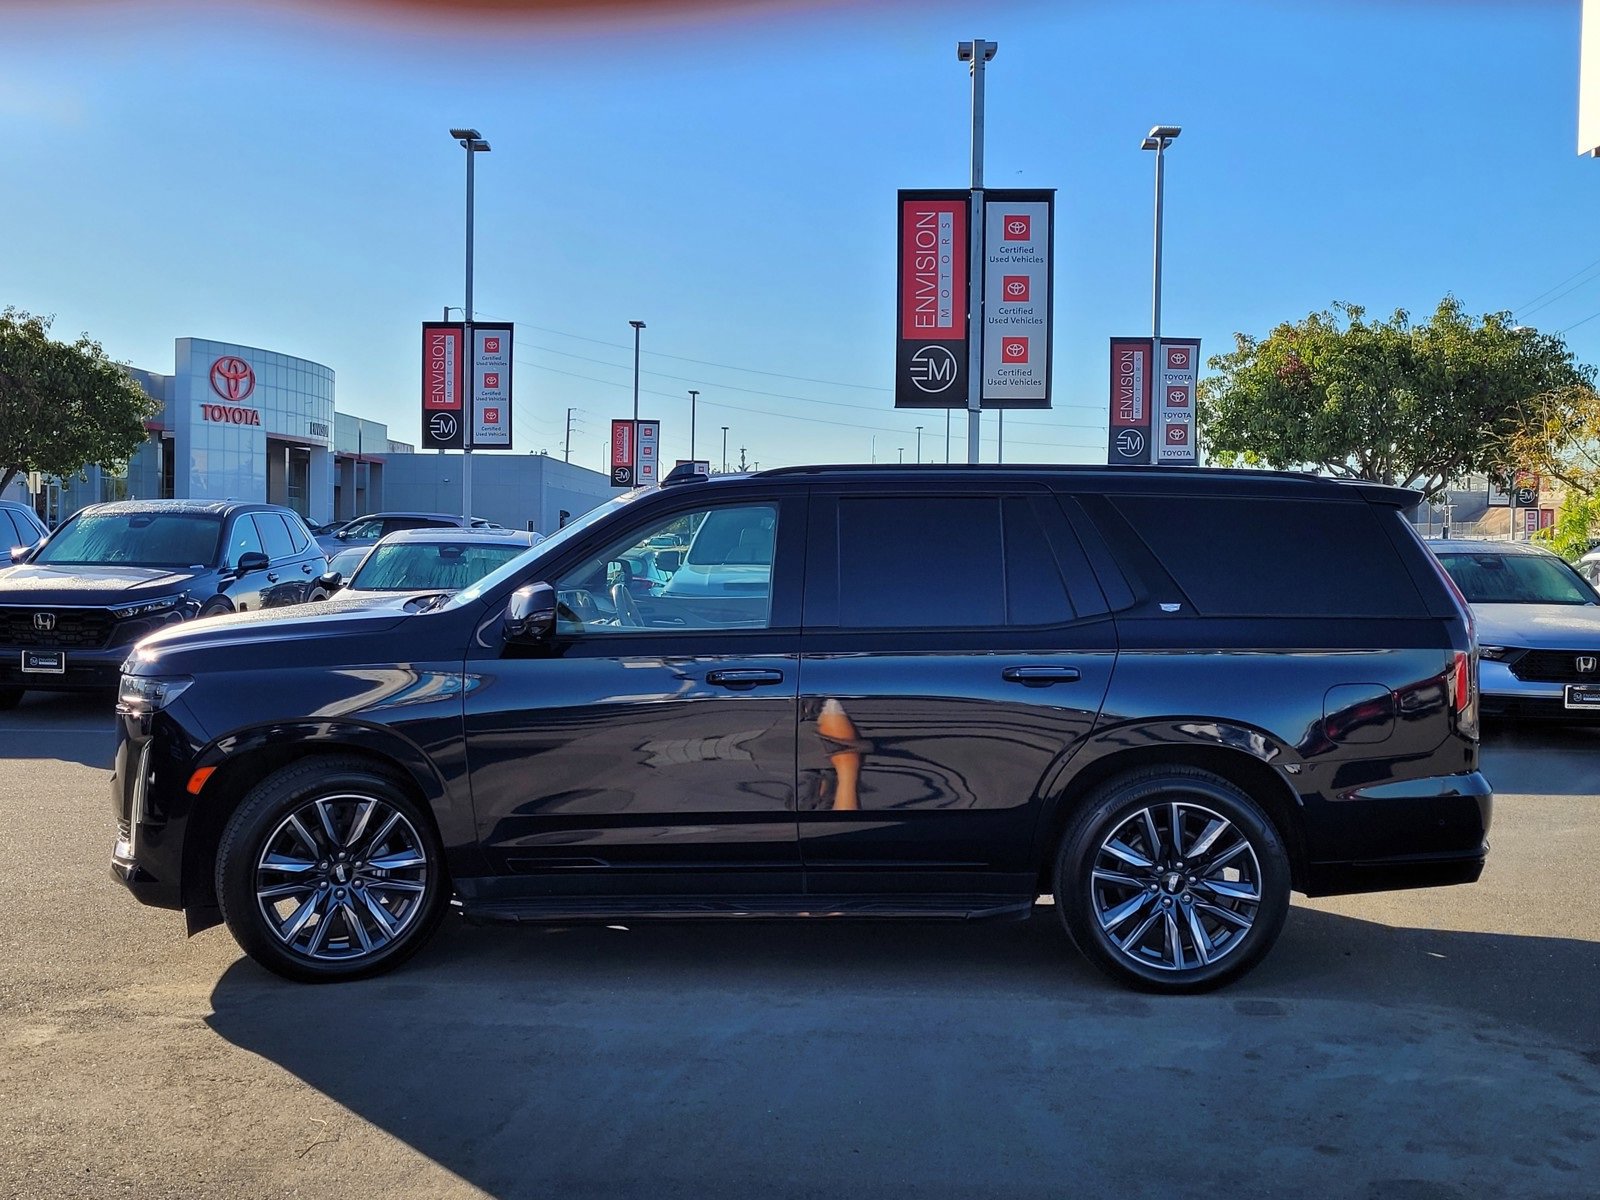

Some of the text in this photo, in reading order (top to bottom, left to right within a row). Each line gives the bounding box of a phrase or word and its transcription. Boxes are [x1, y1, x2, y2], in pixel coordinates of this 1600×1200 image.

[999, 246, 1034, 254] Certified
[915, 211, 936, 328] ENVISION
[941, 221, 950, 318] MOTORS
[988, 317, 1043, 325] Used Vehicles
[998, 307, 1033, 315] Certified
[432, 334, 445, 403] ENVISION
[987, 378, 1042, 386] Used Vehicles
[1120, 350, 1134, 419] ENVISION
[200, 403, 261, 427] TOYOTA
